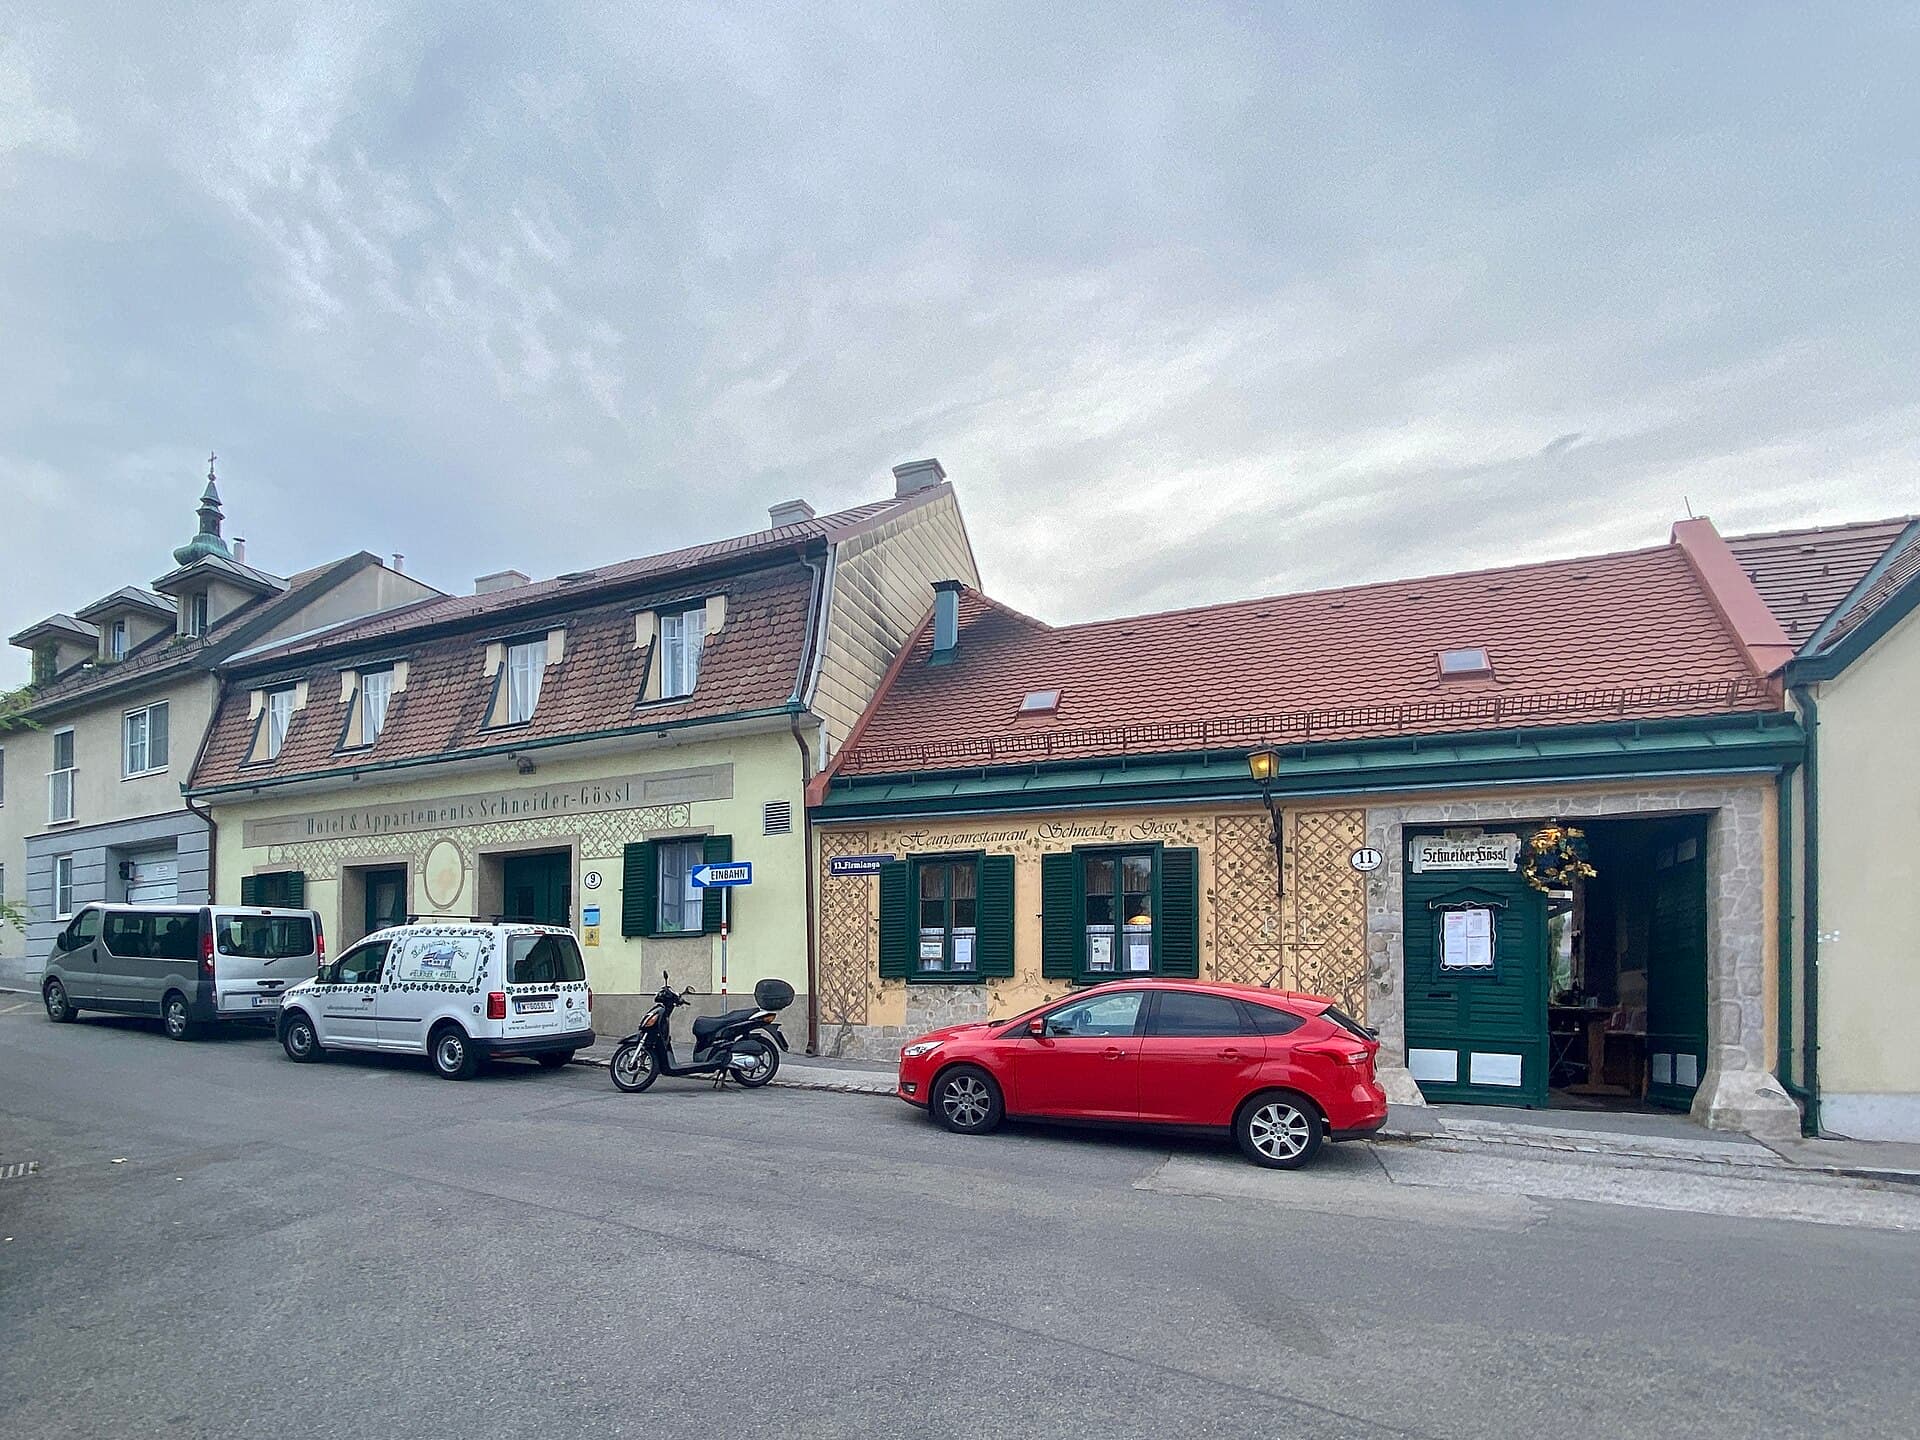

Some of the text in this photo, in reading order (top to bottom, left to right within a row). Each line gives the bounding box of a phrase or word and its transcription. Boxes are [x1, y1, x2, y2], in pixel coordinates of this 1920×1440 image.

[307, 782, 631, 835] Hotel & Appartements Schneider-Gössl
[899, 829, 1028, 849] Heurigenrestaurant
[1038, 820, 1118, 839] Schneider
[1358, 850, 1373, 864] 11
[590, 873, 596, 884] 9
[710, 869, 746, 881] EINBAHN
